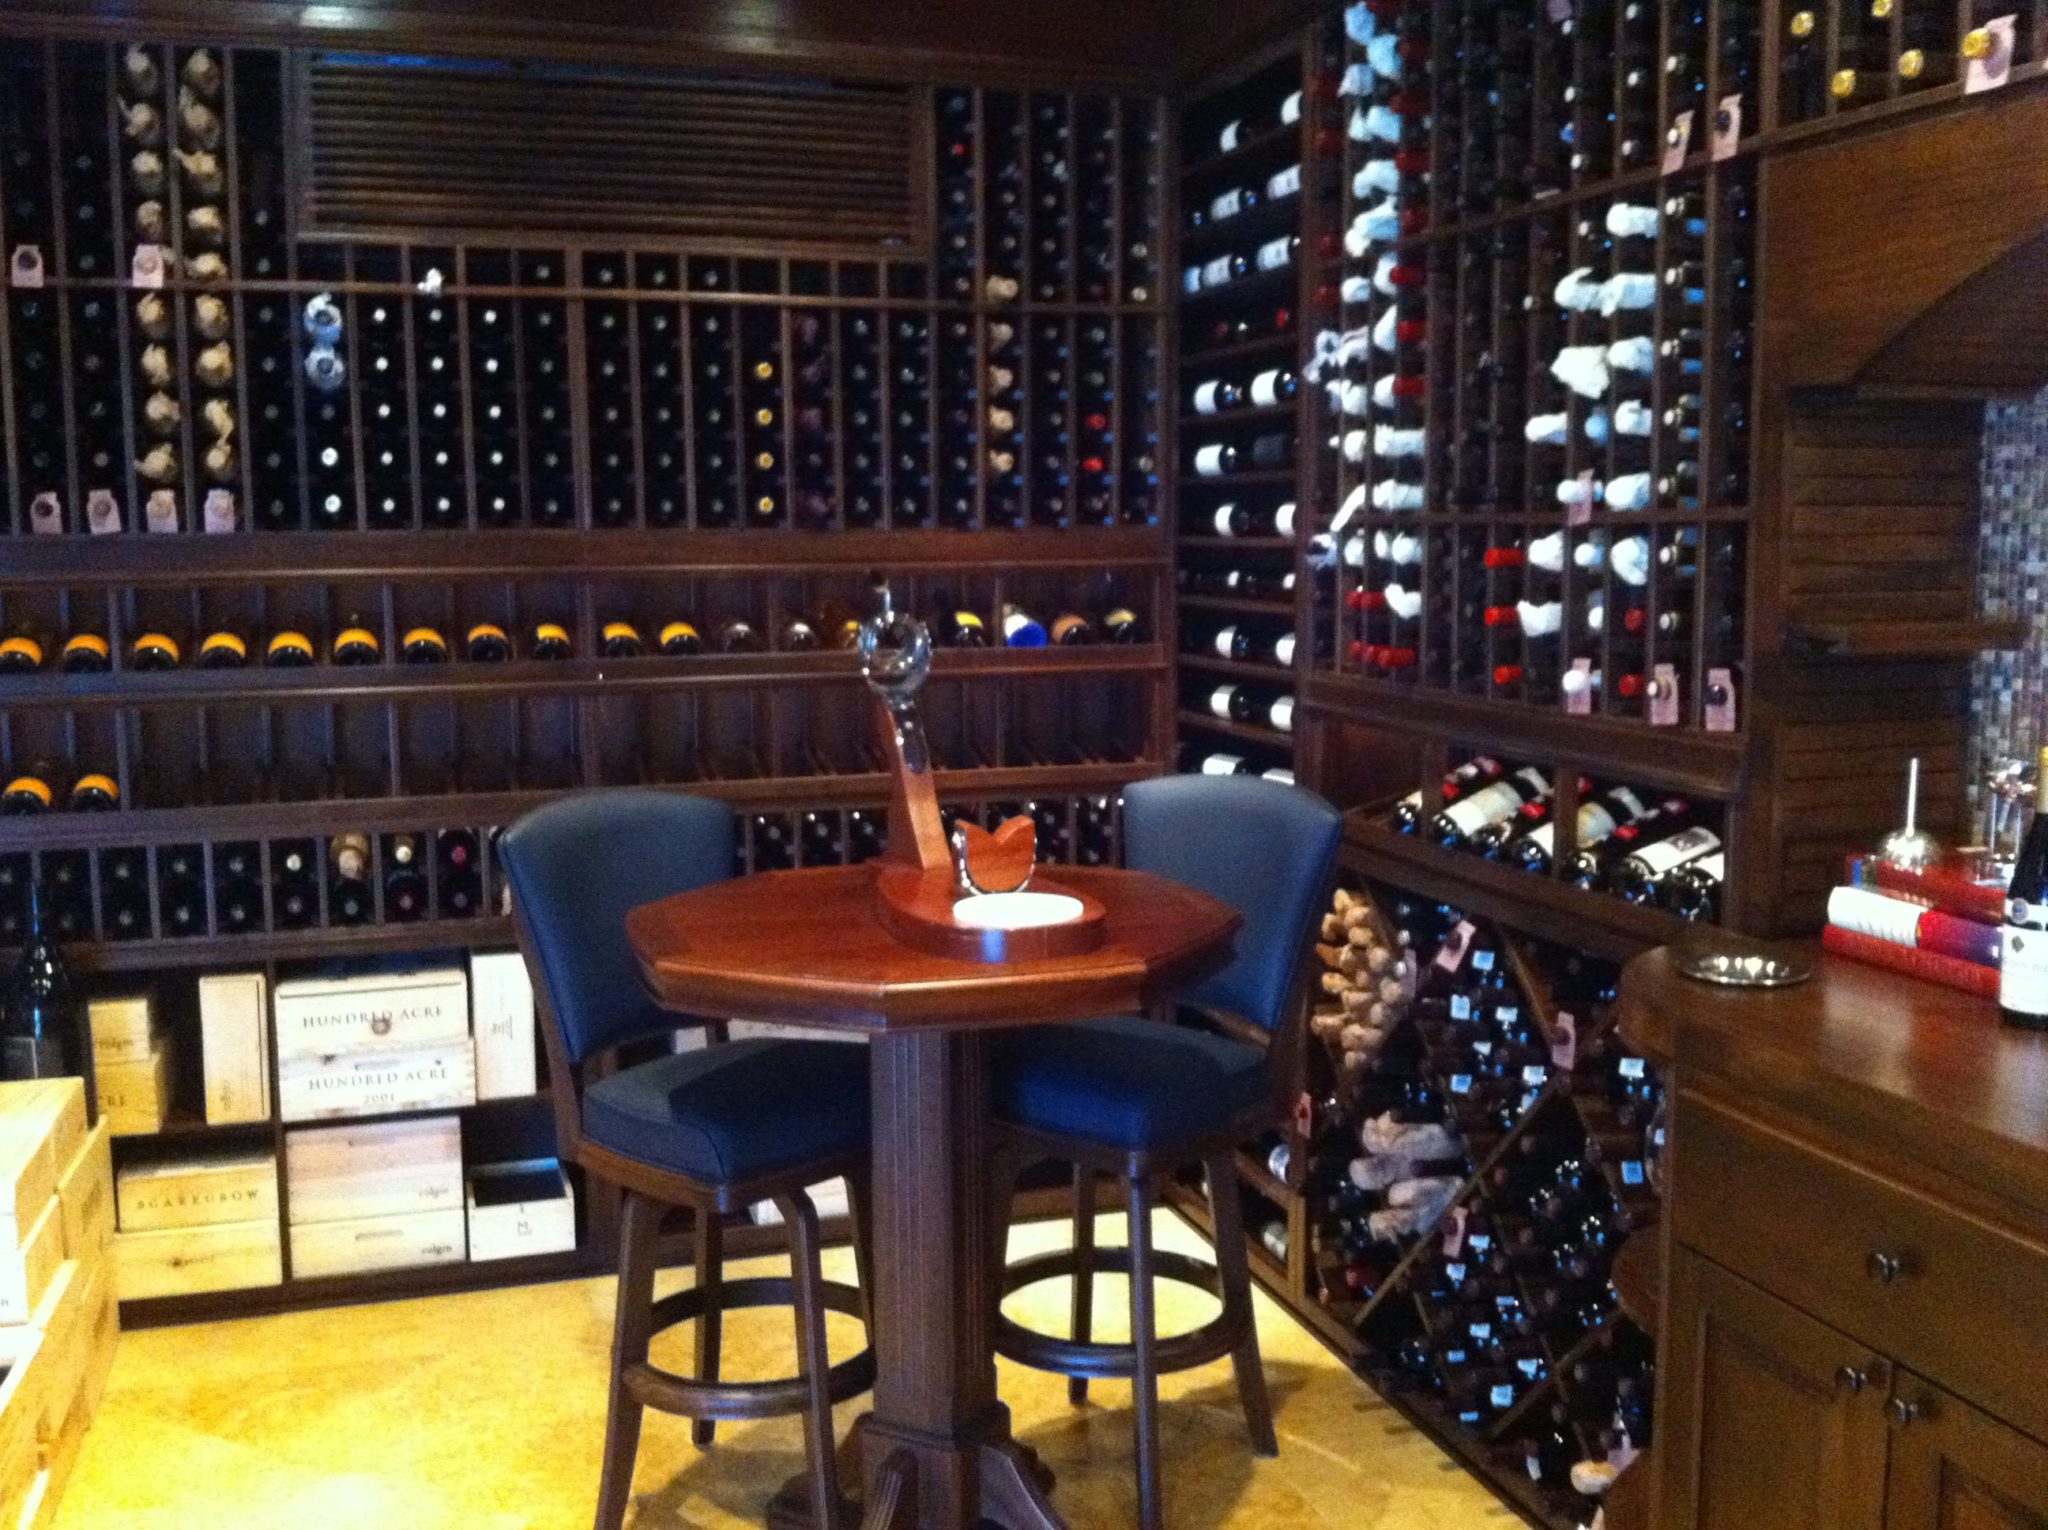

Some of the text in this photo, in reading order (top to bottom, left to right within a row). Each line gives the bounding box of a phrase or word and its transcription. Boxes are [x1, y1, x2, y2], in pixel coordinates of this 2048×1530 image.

[302, 1005, 443, 1029] HUNDRED ACRE
[308, 1067, 448, 1090] HUNDRED ACRE
